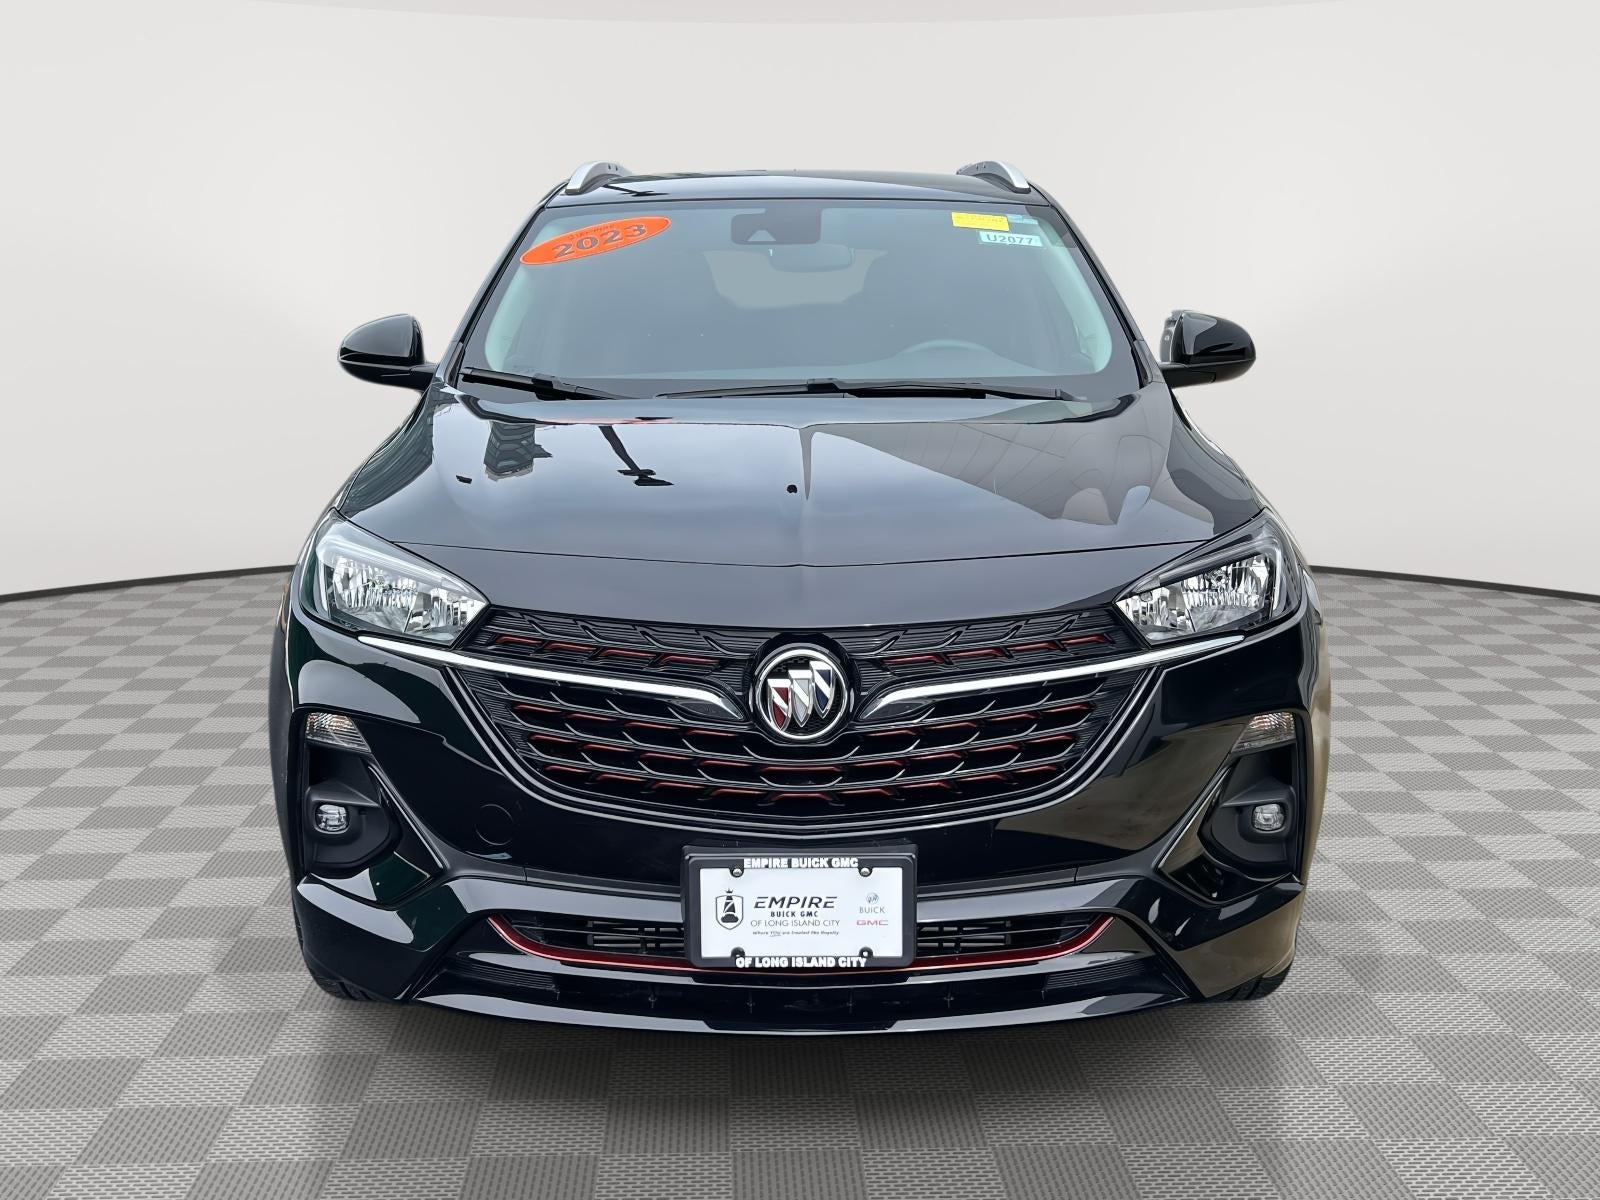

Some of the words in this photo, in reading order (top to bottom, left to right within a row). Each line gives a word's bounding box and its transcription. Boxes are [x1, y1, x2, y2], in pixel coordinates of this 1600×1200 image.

[552, 224, 646, 258] 2023
[986, 234, 1033, 244] U2077
[743, 857, 788, 868] EMPIRE
[791, 858, 829, 868] BUICK
[831, 857, 859, 868] GMC
[754, 896, 838, 909] EMPIRE
[859, 906, 885, 914] BUICK
[750, 919, 762, 927] OF
[764, 919, 789, 927] LONG
[791, 919, 821, 927] ISLAND
[822, 919, 840, 927] CITY
[735, 957, 752, 968] OF
[754, 957, 789, 968] LONG
[791, 957, 836, 968] ISLAND
[838, 957, 867, 967] CITY
